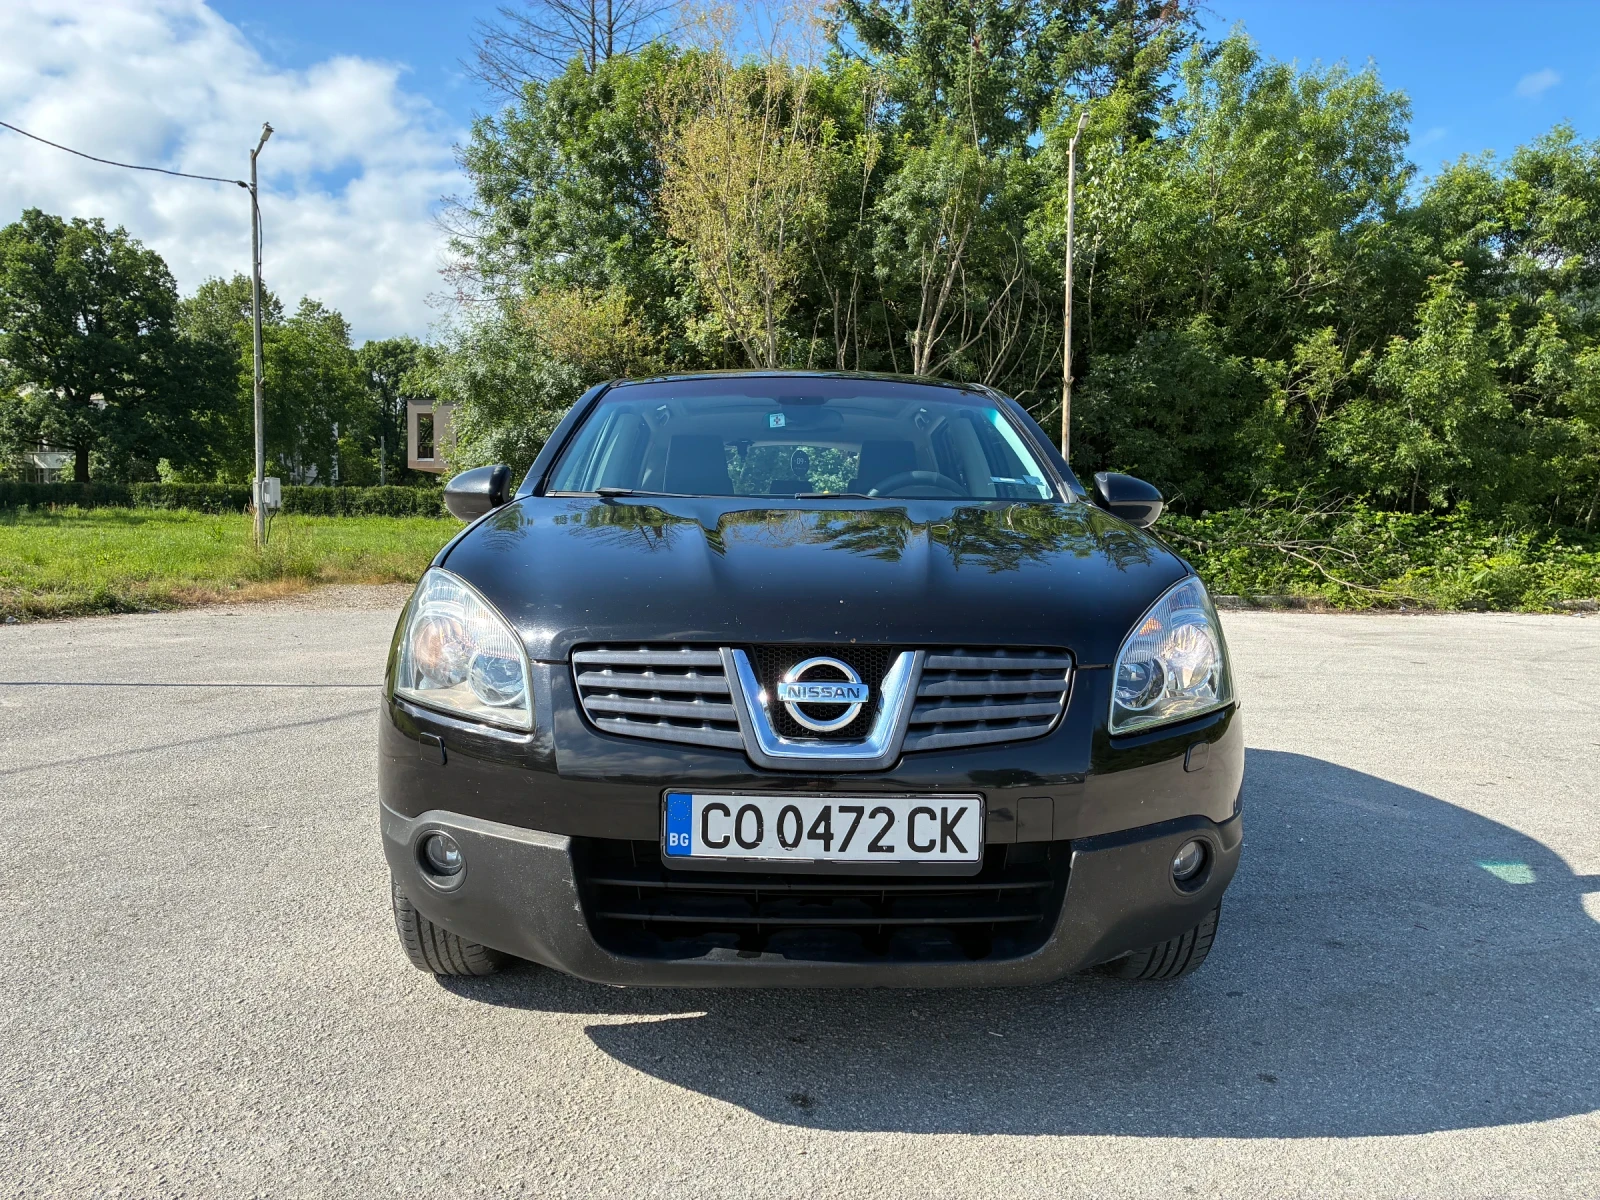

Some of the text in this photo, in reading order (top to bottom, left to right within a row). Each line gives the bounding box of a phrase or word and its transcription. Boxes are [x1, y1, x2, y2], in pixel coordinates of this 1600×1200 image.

[787, 686, 860, 699] NISSAN
[701, 802, 969, 853] CO 0472 CK
[669, 832, 689, 847] BG
